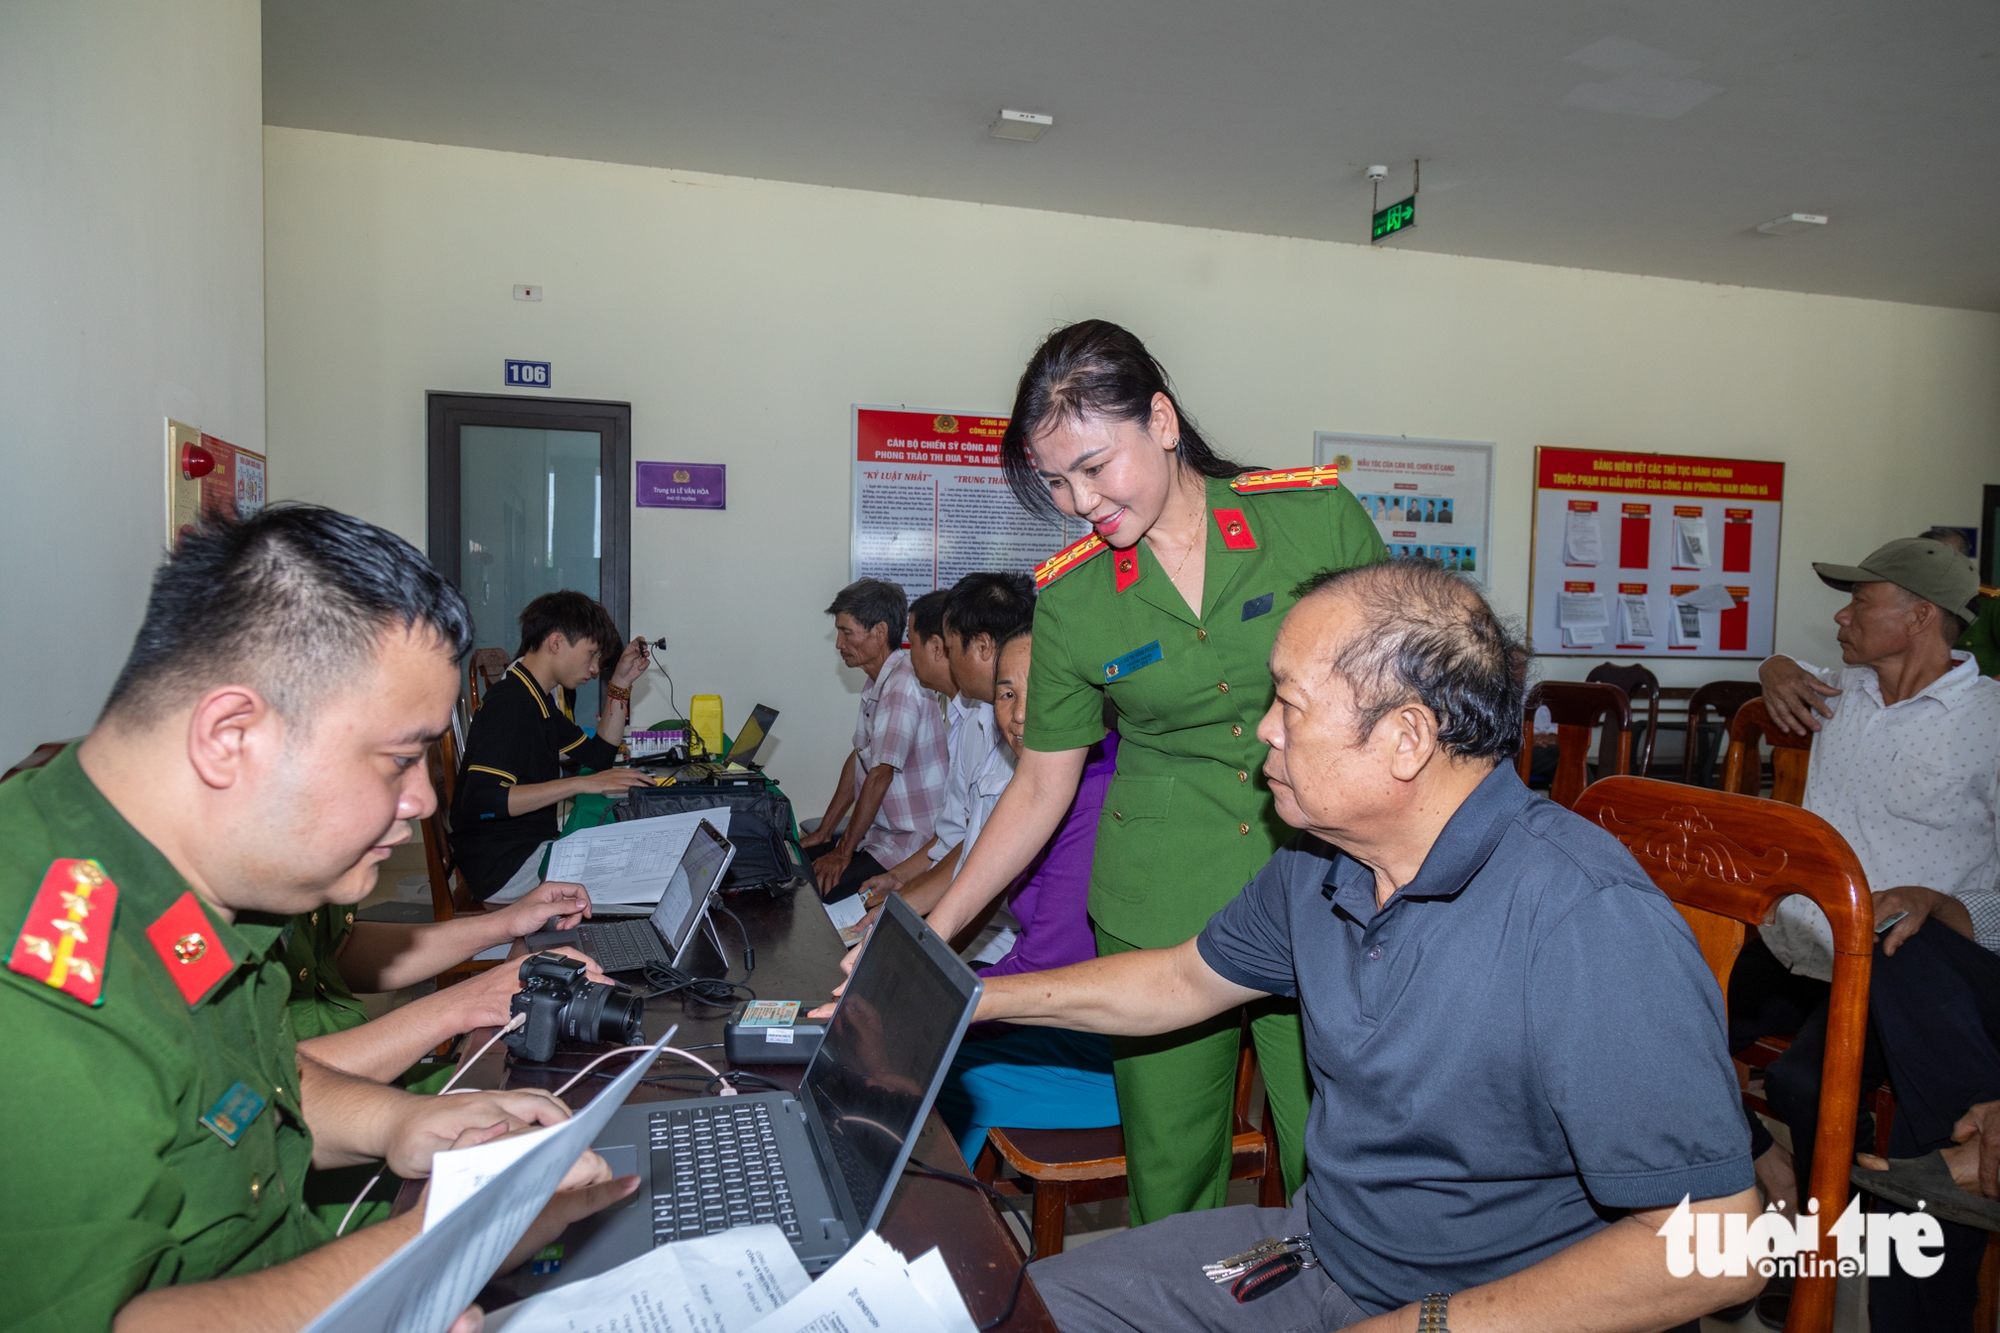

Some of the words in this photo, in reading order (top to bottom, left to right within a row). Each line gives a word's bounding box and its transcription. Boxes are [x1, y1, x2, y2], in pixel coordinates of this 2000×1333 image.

[510, 365, 546, 383] 106
[980, 418, 997, 426] CÔNG
[969, 427, 986, 435] CÔNG
[887, 437, 905, 448] CÁN
[907, 438, 919, 450] BỘ
[920, 439, 946, 450] CHIẾN
[948, 440, 959, 451] SỸ
[961, 440, 983, 452] CÔNG
[985, 443, 998, 452] AN
[875, 450, 905, 460] PHONG
[906, 450, 928, 461] TRÀO
[930, 453, 943, 461] THI
[944, 454, 962, 463] ĐUA
[982, 453, 1002, 465] NHẤ
[1593, 457, 1613, 471] BẢNG
[1634, 461, 1646, 474] YẾT
[1647, 462, 1662, 474] CÁC
[880, 471, 902, 482] LUẬT
[1553, 472, 1577, 487] THUỘC
[1577, 475, 1599, 488] PHẠM
[1600, 476, 1608, 487] VI
[1624, 476, 1646, 489] QUYẾT
[1683, 481, 1693, 491] AN
[1722, 483, 1739, 494] NAM
[653, 487, 669, 495] Trung
[684, 486, 696, 495] VĂN
[697, 487, 709, 495] HÒA
[855, 1297, 880, 1329] GENESTORY
